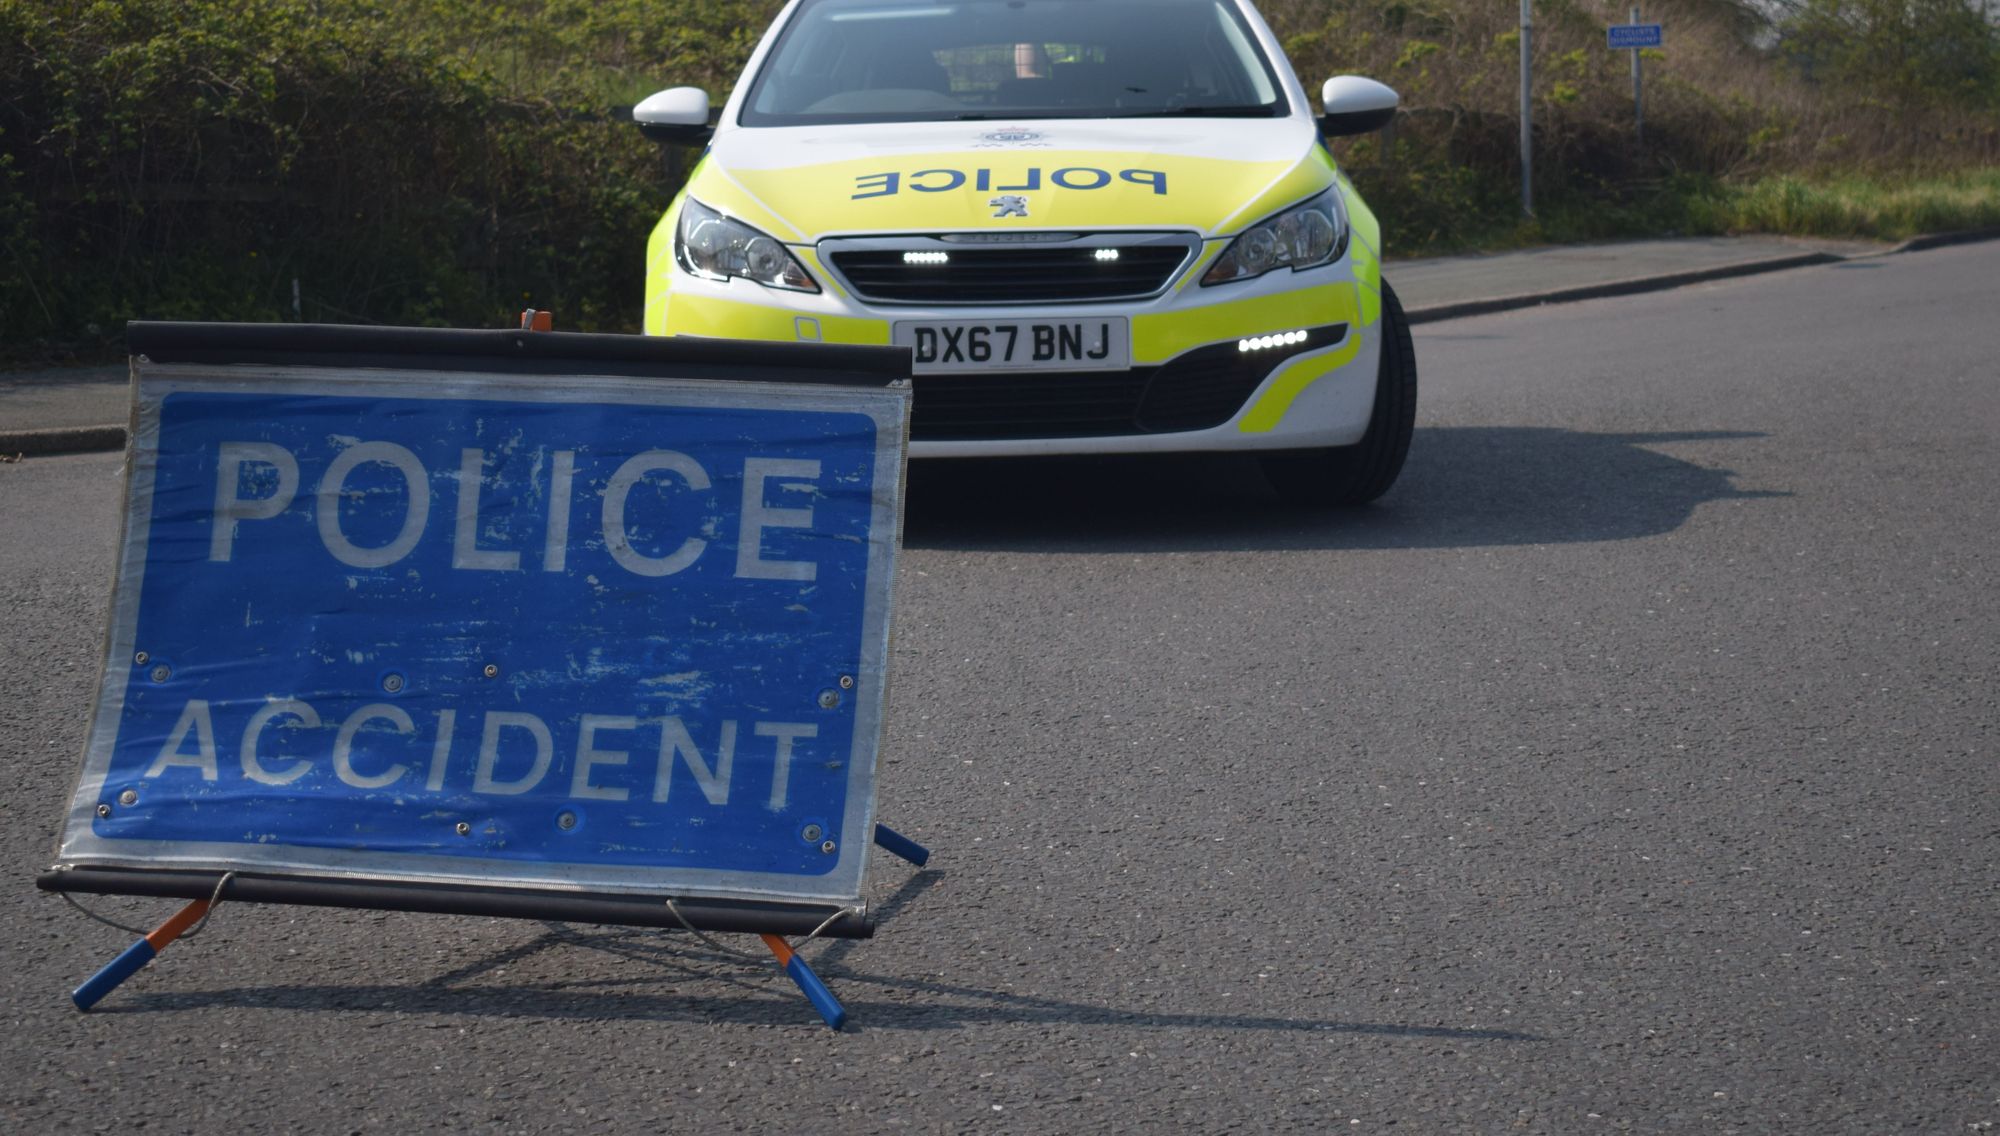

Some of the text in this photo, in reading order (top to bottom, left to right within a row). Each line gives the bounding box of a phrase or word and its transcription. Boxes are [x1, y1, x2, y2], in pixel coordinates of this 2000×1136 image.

[914, 323, 1109, 363] DX67 BNJ
[206, 439, 822, 582] POLICE
[146, 698, 819, 812] ACCIDENT
